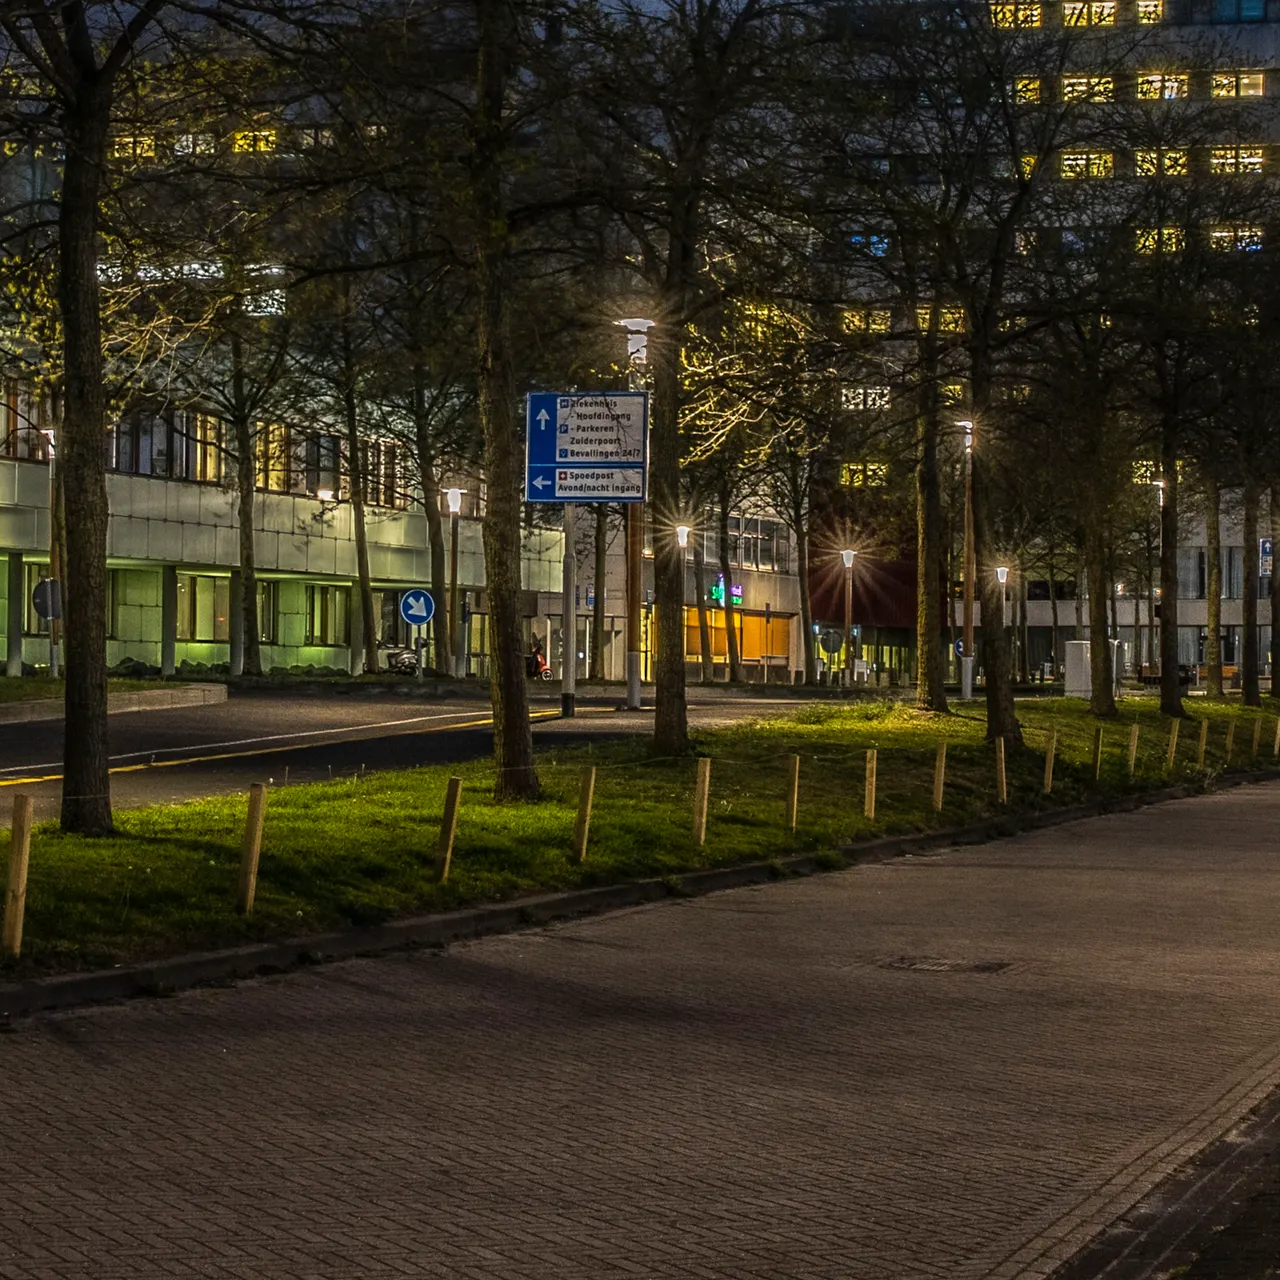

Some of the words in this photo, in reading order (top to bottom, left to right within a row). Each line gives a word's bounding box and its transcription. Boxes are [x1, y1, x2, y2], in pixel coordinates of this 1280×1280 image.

[571, 400, 618, 408] Ziekenhuis
[576, 412, 631, 422] Hoofdingang
[576, 425, 615, 433] Parkeren
[570, 437, 621, 447] Zuiderpoort
[570, 449, 620, 459] Bevallingen
[622, 449, 641, 457] 24/7
[569, 472, 614, 481] Spoedpost
[558, 483, 610, 493] Avond/nacht
[612, 484, 641, 493] ingang
